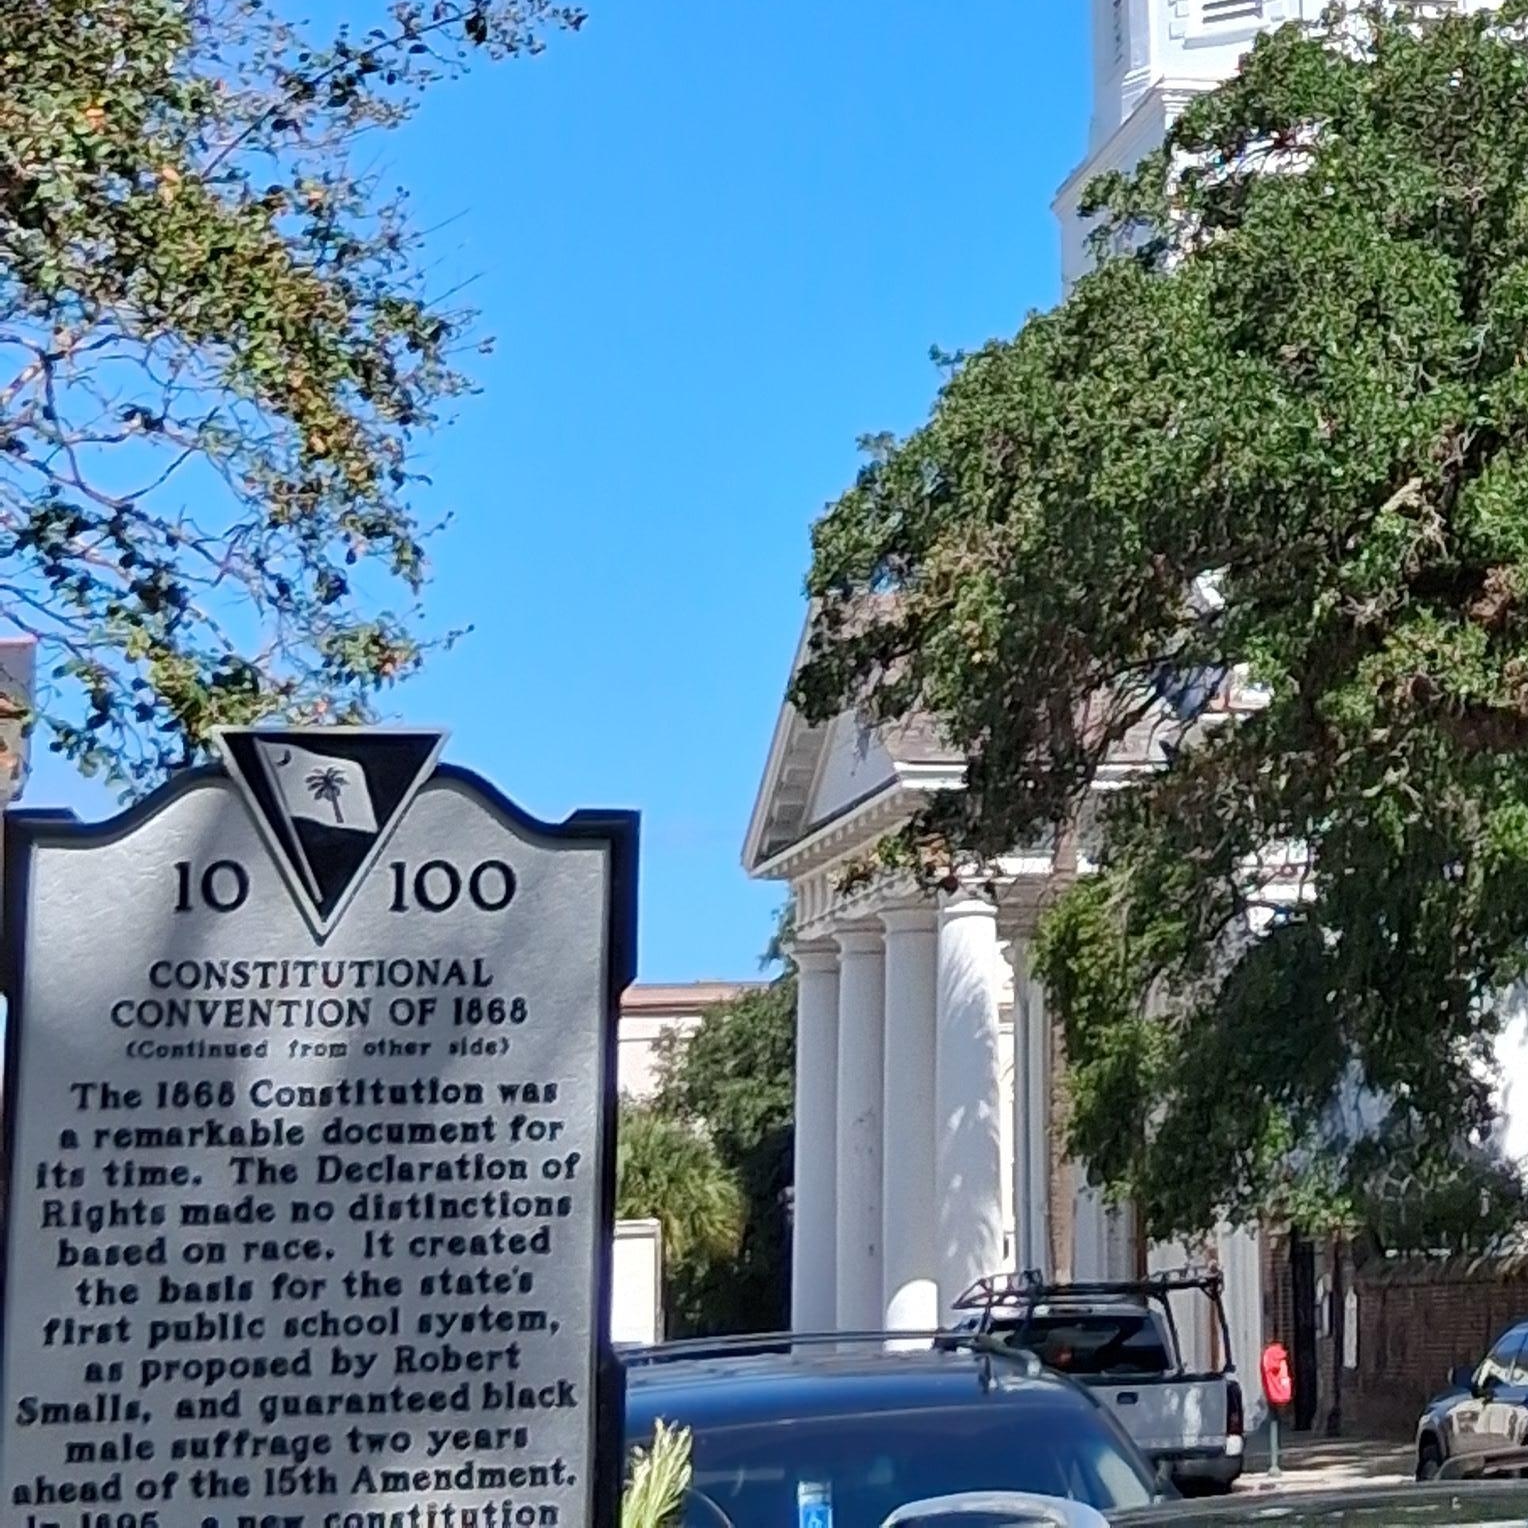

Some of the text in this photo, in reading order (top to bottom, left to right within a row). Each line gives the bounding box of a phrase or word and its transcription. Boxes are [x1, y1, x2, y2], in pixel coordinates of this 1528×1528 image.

[173, 859, 517, 915] 10 100
[148, 957, 494, 991] CONSTITUTIONAL
[110, 996, 528, 1029] CONVENTION OF 1868
[125, 1036, 510, 1060] (Continued from other side)
[69, 1076, 558, 1111] The 1868 Constitution was
[58, 1113, 564, 1150] a remarkable document for
[35, 1151, 581, 1190] its time. The Declaration of
[40, 1190, 572, 1234] Rights made no distinctions
[56, 1224, 551, 1269] based on race. It created
[75, 1266, 533, 1307] the basis for the state's
[42, 1304, 560, 1350] first public school system,
[84, 1342, 521, 1389] as proposed by Robert
[15, 1379, 578, 1427] Smalls, and guaranteed black
[64, 1426, 528, 1465] male suffrage two years
[12, 1457, 577, 1506] ahead of the 15th Amendment.
[324, 1500, 558, 1528] constitution
